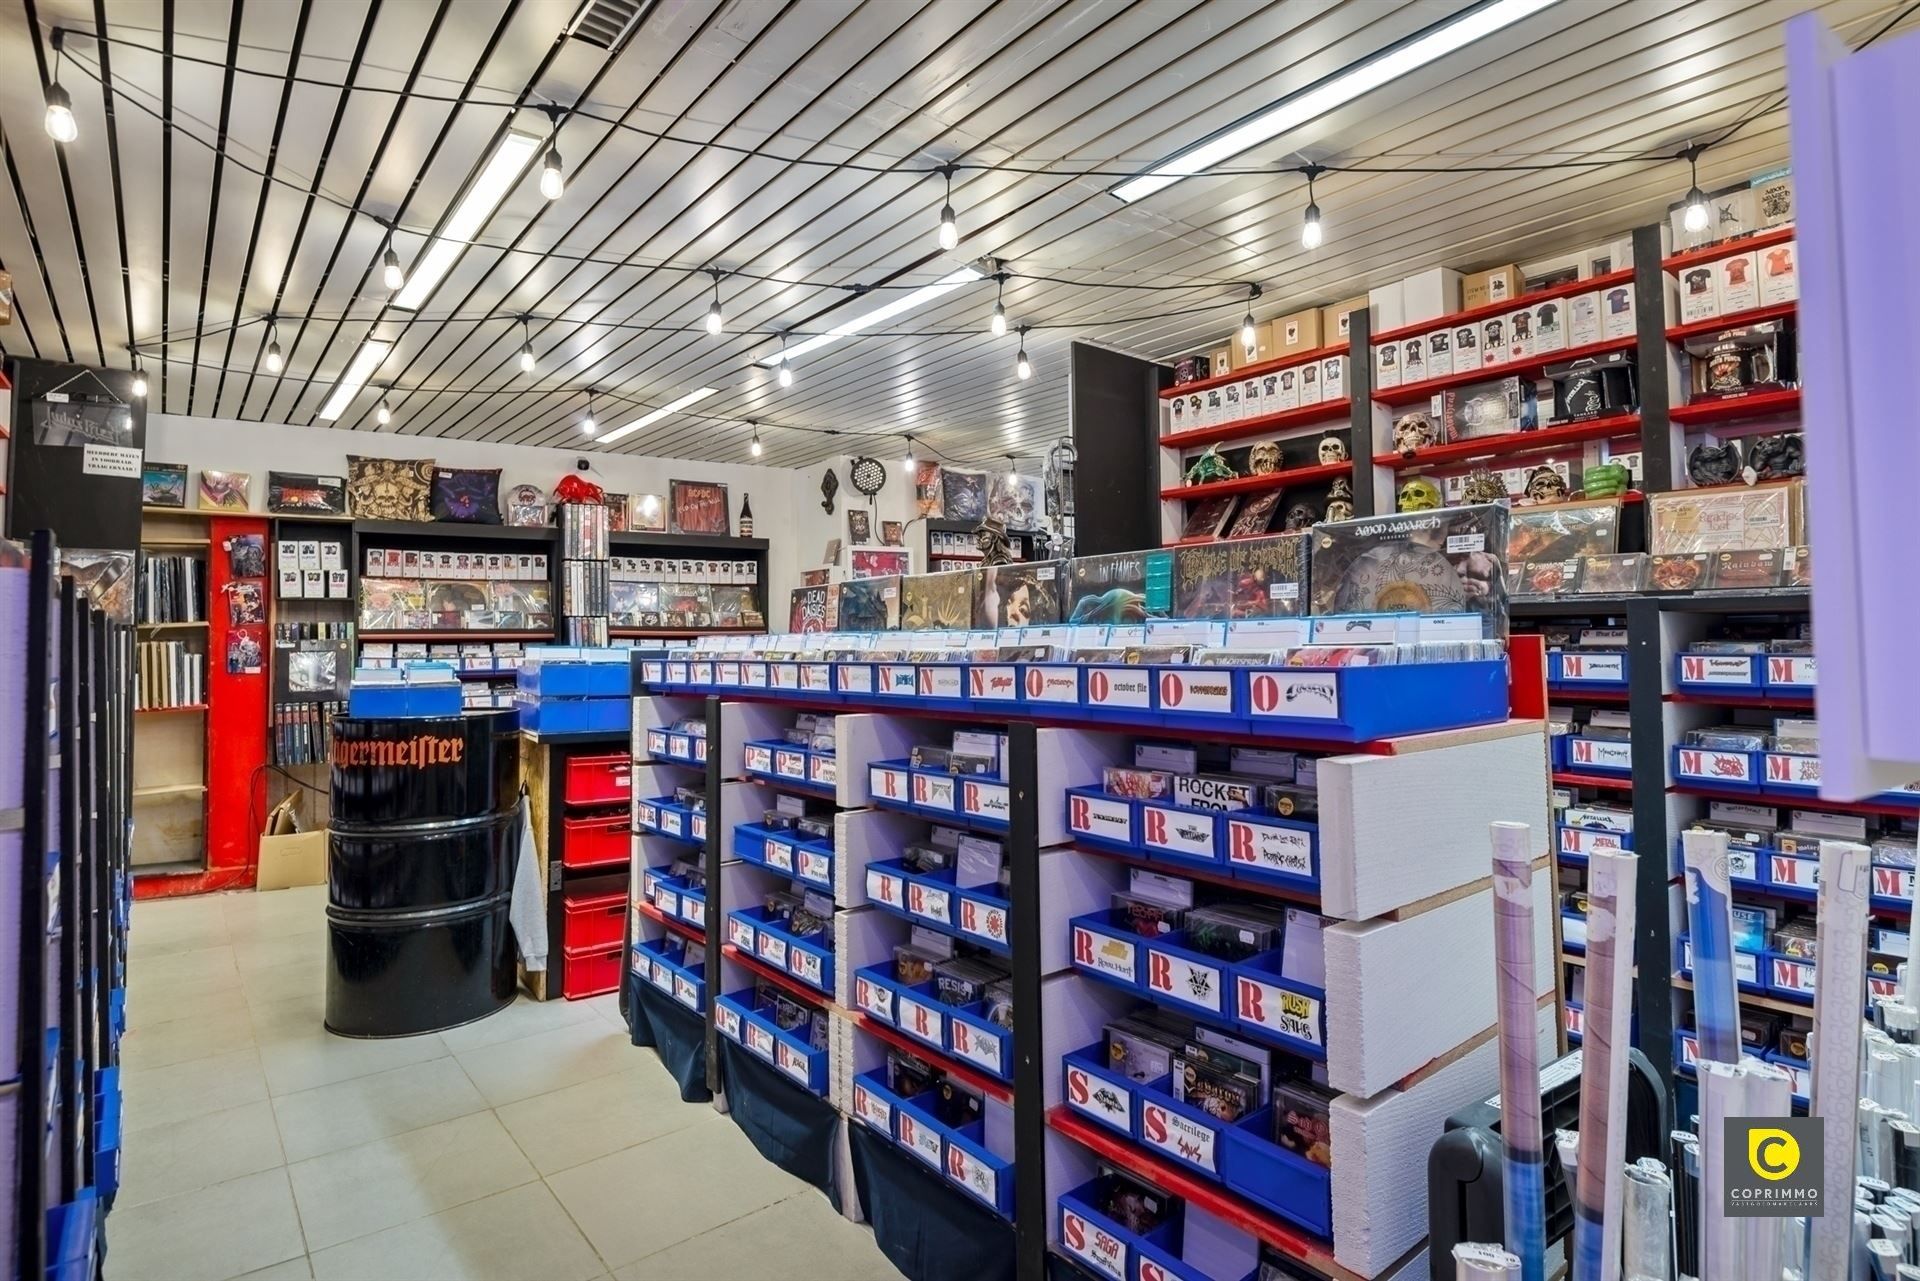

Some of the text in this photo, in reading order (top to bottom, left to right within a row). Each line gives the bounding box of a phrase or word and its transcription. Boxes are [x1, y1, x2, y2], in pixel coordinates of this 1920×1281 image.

[687, 489, 711, 498] AC/DC
[1354, 516, 1442, 538] AMON AMARTH
[1721, 561, 1773, 571] Rainbow
[807, 590, 825, 604] DEAD
[741, 665, 750, 685] N
[771, 665, 780, 687] N
[801, 665, 811, 688] N
[839, 667, 849, 690] N
[880, 667, 891, 692] N
[1565, 656, 1583, 678] M
[1684, 658, 1705, 681] M
[1770, 659, 1794, 683] M
[920, 669, 933, 695] N
[971, 669, 984, 696] N
[1027, 668, 1043, 698] O
[1090, 671, 1108, 702] O
[1113, 682, 1136, 692] october
[1162, 673, 1183, 707] O
[1253, 675, 1279, 712] O
[746, 747, 754, 768] P
[777, 752, 787, 773] P
[1574, 741, 1593, 763] M
[1682, 751, 1703, 775] M
[812, 757, 821, 779] P
[1768, 756, 1792, 781] M
[884, 772, 896, 797] R
[914, 776, 928, 803] R
[1179, 777, 1250, 801] ROCKET
[965, 783, 980, 813] R
[1072, 798, 1091, 831] R
[1146, 809, 1168, 845] R
[1579, 814, 1615, 824] METALLICA
[767, 841, 776, 863] P
[1231, 824, 1256, 862] R
[1563, 830, 1581, 852] M
[800, 853, 809, 875] P
[1773, 857, 1798, 884] M
[880, 875, 893, 902] R
[1876, 868, 1902, 896] M
[692, 900, 699, 920] P
[911, 885, 924, 913] R
[963, 901, 977, 932] R
[1734, 909, 1756, 921] USE
[730, 917, 738, 940] P
[758, 932, 769, 956] P
[1075, 929, 1095, 965] R
[653, 963, 660, 982] P
[791, 949, 805, 971] Q
[1151, 952, 1173, 992] R
[675, 976, 684, 996] P
[1775, 960, 1800, 989] M
[856, 980, 870, 1008] R
[1239, 979, 1265, 1023] R
[1280, 991, 1312, 1019] RUSH
[915, 1004, 929, 1036] R
[1564, 1008, 1581, 1031] M
[747, 1022, 757, 1048] R
[953, 1021, 969, 1054] R
[778, 1042, 790, 1069] R
[1070, 1070, 1089, 1105] S
[856, 1086, 869, 1116] R
[900, 1115, 915, 1147] R
[1146, 1106, 1211, 1143] S Sacrilege
[949, 1147, 966, 1182] R
[1066, 1214, 1086, 1251] S
[1095, 1231, 1119, 1260] SAGA
